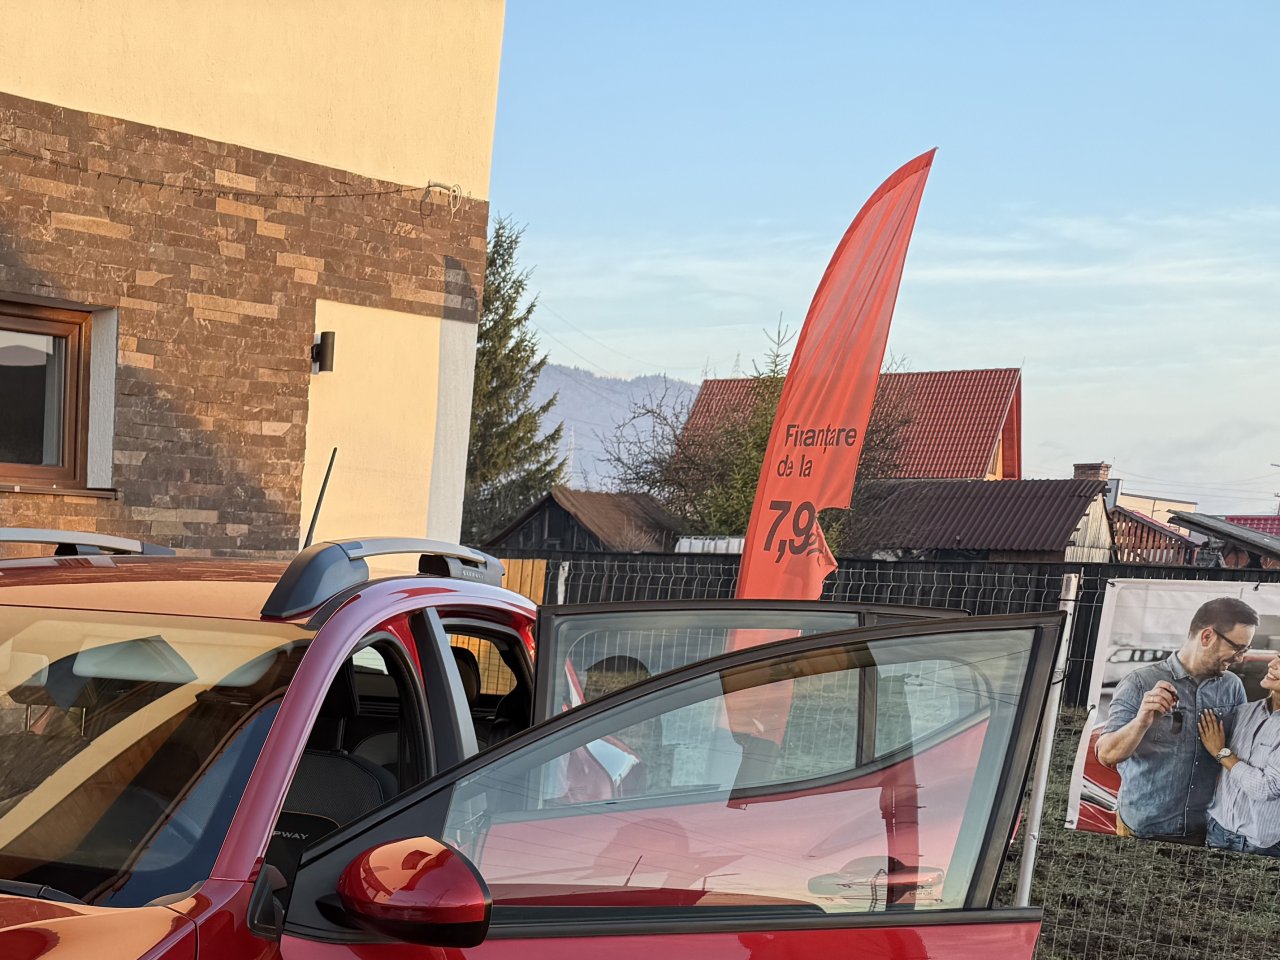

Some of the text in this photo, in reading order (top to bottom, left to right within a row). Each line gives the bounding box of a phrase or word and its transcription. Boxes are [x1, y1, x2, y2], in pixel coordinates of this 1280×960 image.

[777, 454, 813, 477] de la
[272, 830, 309, 840] PWAY
